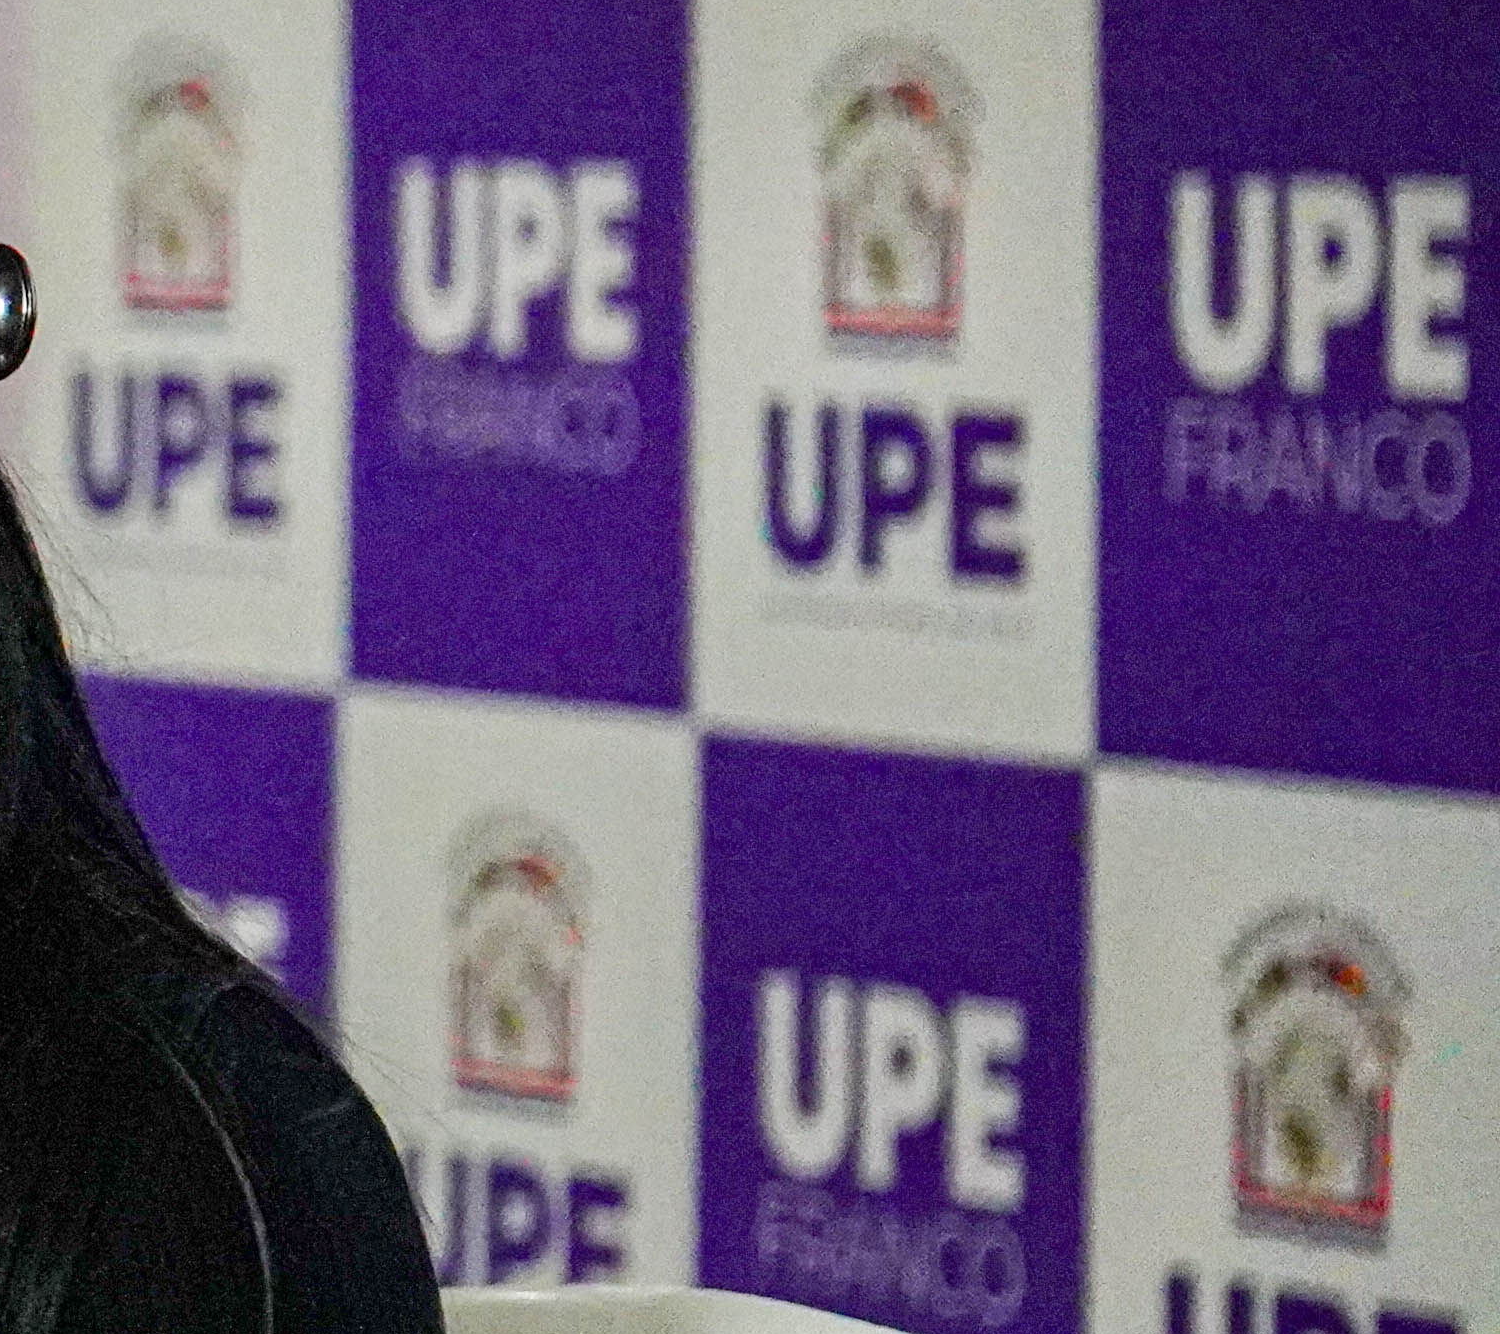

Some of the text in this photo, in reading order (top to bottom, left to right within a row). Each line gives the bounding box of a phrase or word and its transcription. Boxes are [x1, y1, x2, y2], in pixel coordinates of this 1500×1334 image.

[397, 161, 637, 363] UPE
[1170, 173, 1470, 400] UPE
[72, 369, 284, 529] UPE
[764, 402, 1027, 586] UPE
[1162, 397, 1472, 527] FRANCO
[758, 970, 1025, 1210] UPE
